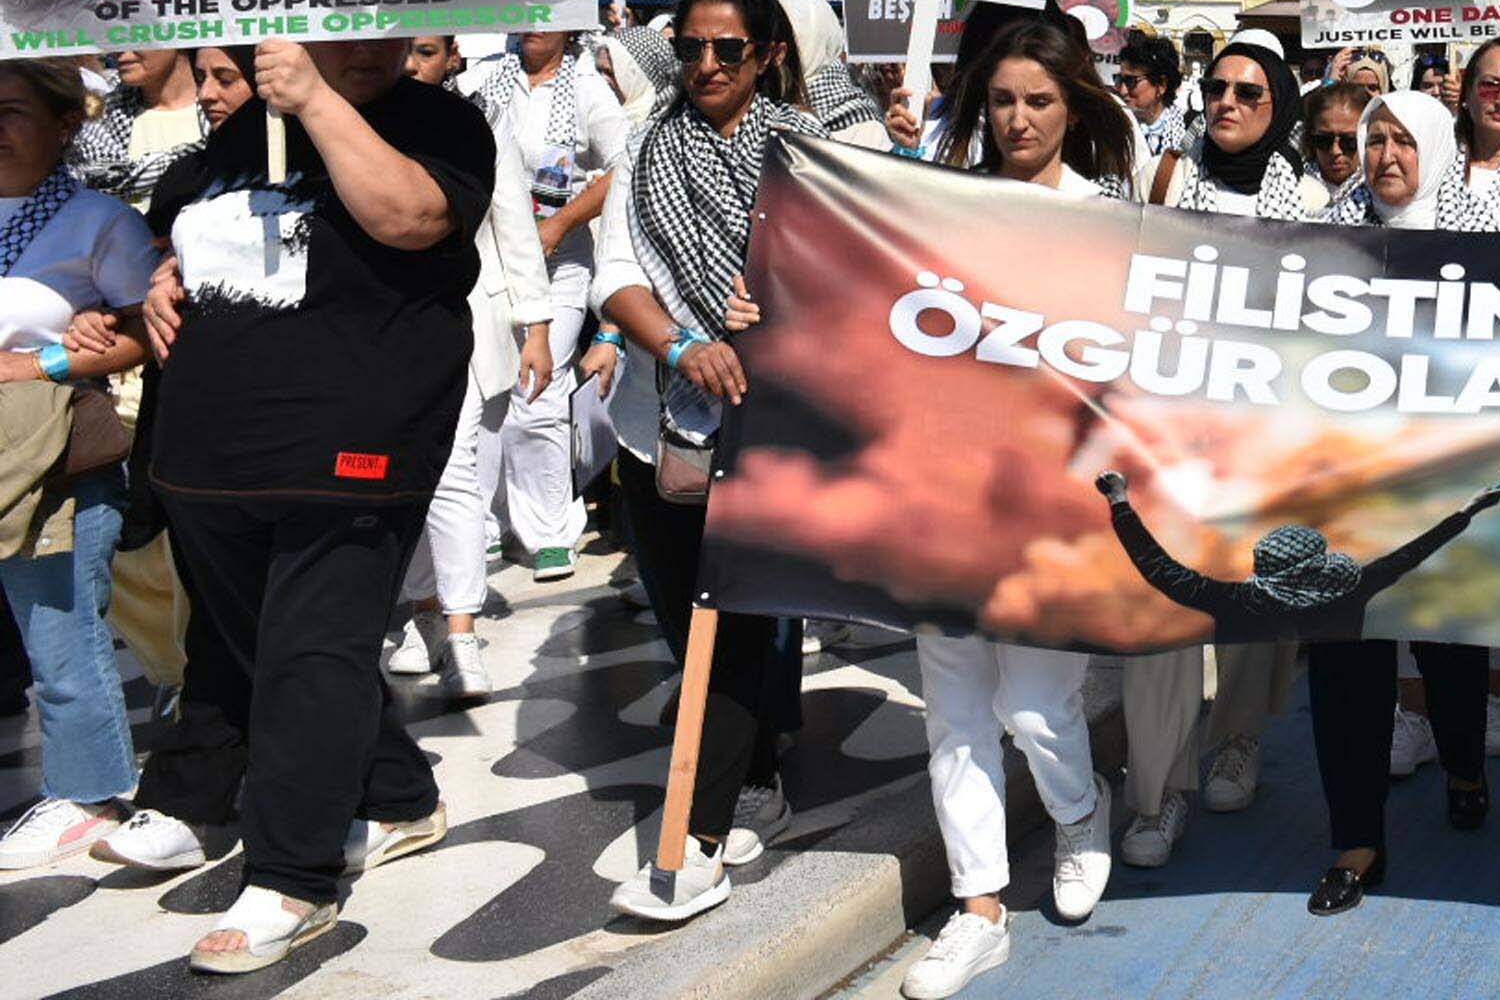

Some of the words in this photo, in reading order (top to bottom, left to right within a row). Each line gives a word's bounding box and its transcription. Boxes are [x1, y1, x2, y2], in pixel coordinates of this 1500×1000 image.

[93, 0, 140, 21] OF
[1390, 7, 1453, 25] ONE
[11, 28, 96, 50] WILL
[105, 20, 223, 44] CRUSH
[235, 14, 309, 36] THE
[321, 4, 553, 33] OPPRESSOR
[1314, 27, 1403, 44] JUSTICE
[1410, 24, 1463, 40] WILL
[1470, 23, 1496, 37] BE
[889, 270, 1284, 405] ÖZGÜR
